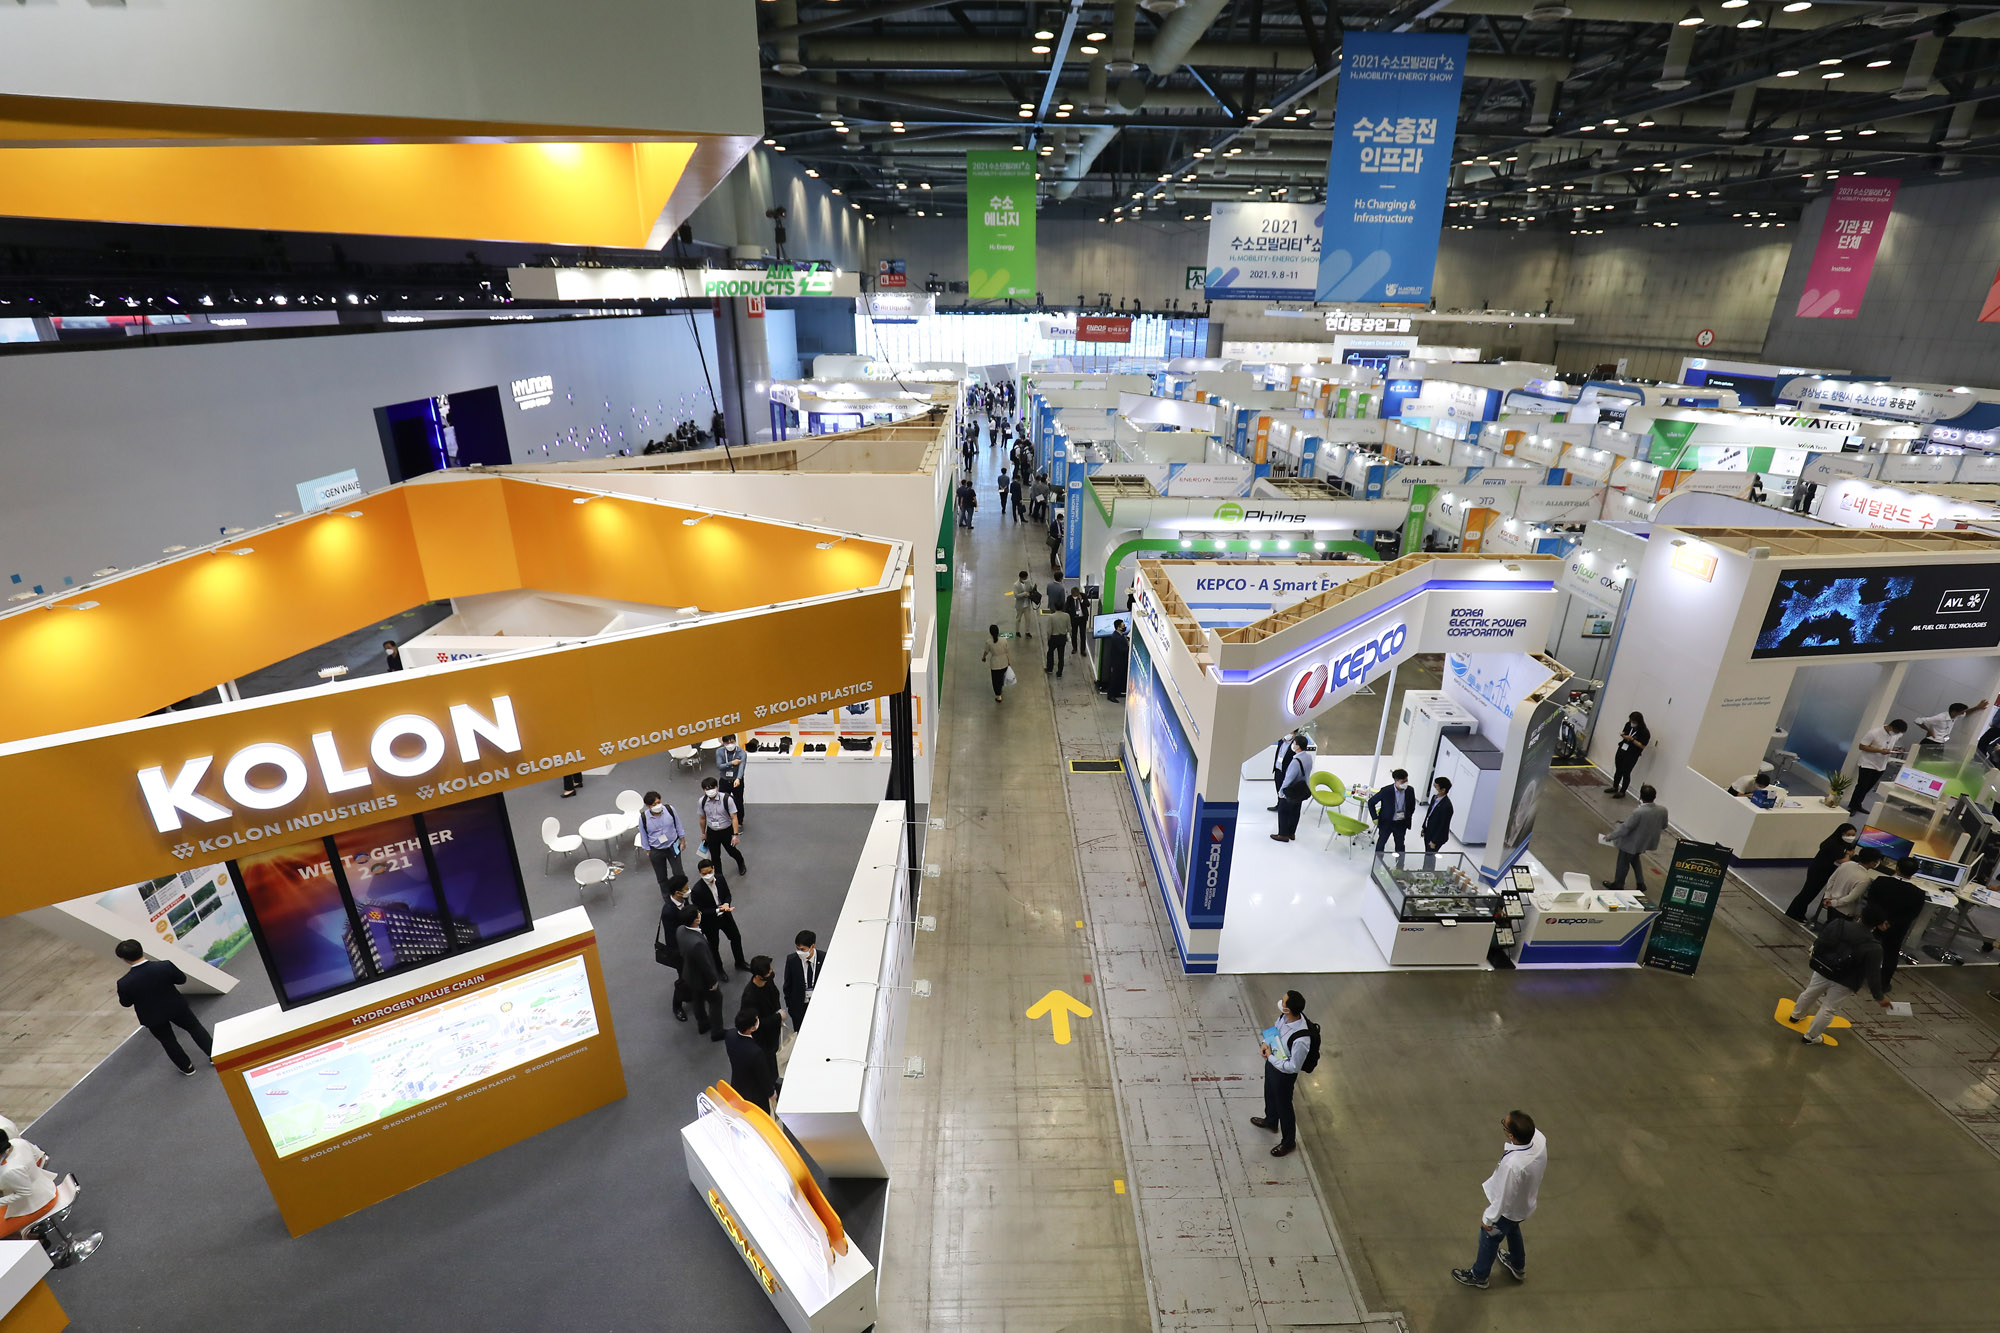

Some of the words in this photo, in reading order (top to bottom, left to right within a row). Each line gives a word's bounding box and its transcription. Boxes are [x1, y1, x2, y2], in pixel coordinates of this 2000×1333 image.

[1352, 54, 1379, 69] 2021
[1429, 73, 1453, 82] SHOW
[1352, 116, 1438, 145] 수소충전
[1360, 147, 1424, 175] 인프라
[990, 195, 1014, 210] 수소
[1367, 199, 1408, 211] Charging
[1408, 199, 1417, 209] &
[984, 211, 1020, 226] 에너지
[1353, 212, 1414, 224] Infrastructure
[1262, 219, 1298, 234] 2021
[1835, 220, 1860, 234] 기관
[1860, 220, 1874, 235] 및
[1837, 235, 1862, 250] 단체
[766, 264, 796, 280] AIR
[705, 280, 796, 297] PRODUCTS
[889, 304, 912, 312] Liquide
[1050, 327, 1077, 336] Pana
[1325, 318, 1412, 333] 현대중공업그룹
[511, 375, 553, 397] HYUNDAI
[1855, 394, 1888, 407] 수소산업
[1889, 398, 1917, 411] 공동관
[340, 480, 361, 493] WAVE
[1401, 477, 1427, 485] daeha
[1244, 510, 1307, 523] Philos
[1441, 502, 1453, 516] GTC
[1854, 497, 1912, 524] 네덜란드
[1196, 578, 1247, 591] KEPCO
[1258, 578, 1271, 591] A
[1273, 578, 1318, 591] Smart
[1321, 579, 1340, 592] En
[1944, 597, 1964, 608] AVL
[1450, 608, 1484, 618] KOREA
[1448, 618, 1490, 628] ELECTRIC
[1490, 618, 1527, 628] POWER
[1948, 622, 1988, 630] TECHNOLOGIES
[1447, 628, 1515, 638] CORPORATION
[1328, 622, 1407, 694] KEPCO
[769, 694, 818, 715] KOLON
[820, 680, 874, 703] PLASTICS
[617, 727, 674, 753] KOLON
[676, 711, 742, 738] GLOTECH
[136, 694, 522, 833] KOLON
[438, 766, 511, 796] KOLON
[515, 749, 586, 777] GLOBAL
[198, 821, 282, 854] KOLON
[285, 793, 399, 832] INDUSTRIES
[297, 859, 334, 882] WE
[1206, 843, 1222, 888] KEPCO
[1675, 860, 1704, 873] BIXPO
[1703, 866, 1722, 876] 2021
[1558, 917, 1588, 926] KEPCO
[351, 996, 416, 1027] HYDROGEN
[415, 985, 452, 1006] VALUE
[451, 973, 486, 994] CHAIN
[531, 1058, 555, 1074] KOLON
[555, 1046, 589, 1064] INDUSTRIES
[462, 1085, 489, 1100] KOLON
[488, 1074, 517, 1090] PLASTICS
[389, 1112, 417, 1128] KOLON
[416, 1101, 448, 1118] GLOTECH
[309, 1142, 341, 1161] KOLON
[341, 1131, 373, 1148] GLOBAL
[708, 1188, 776, 1295] ECOMATE
